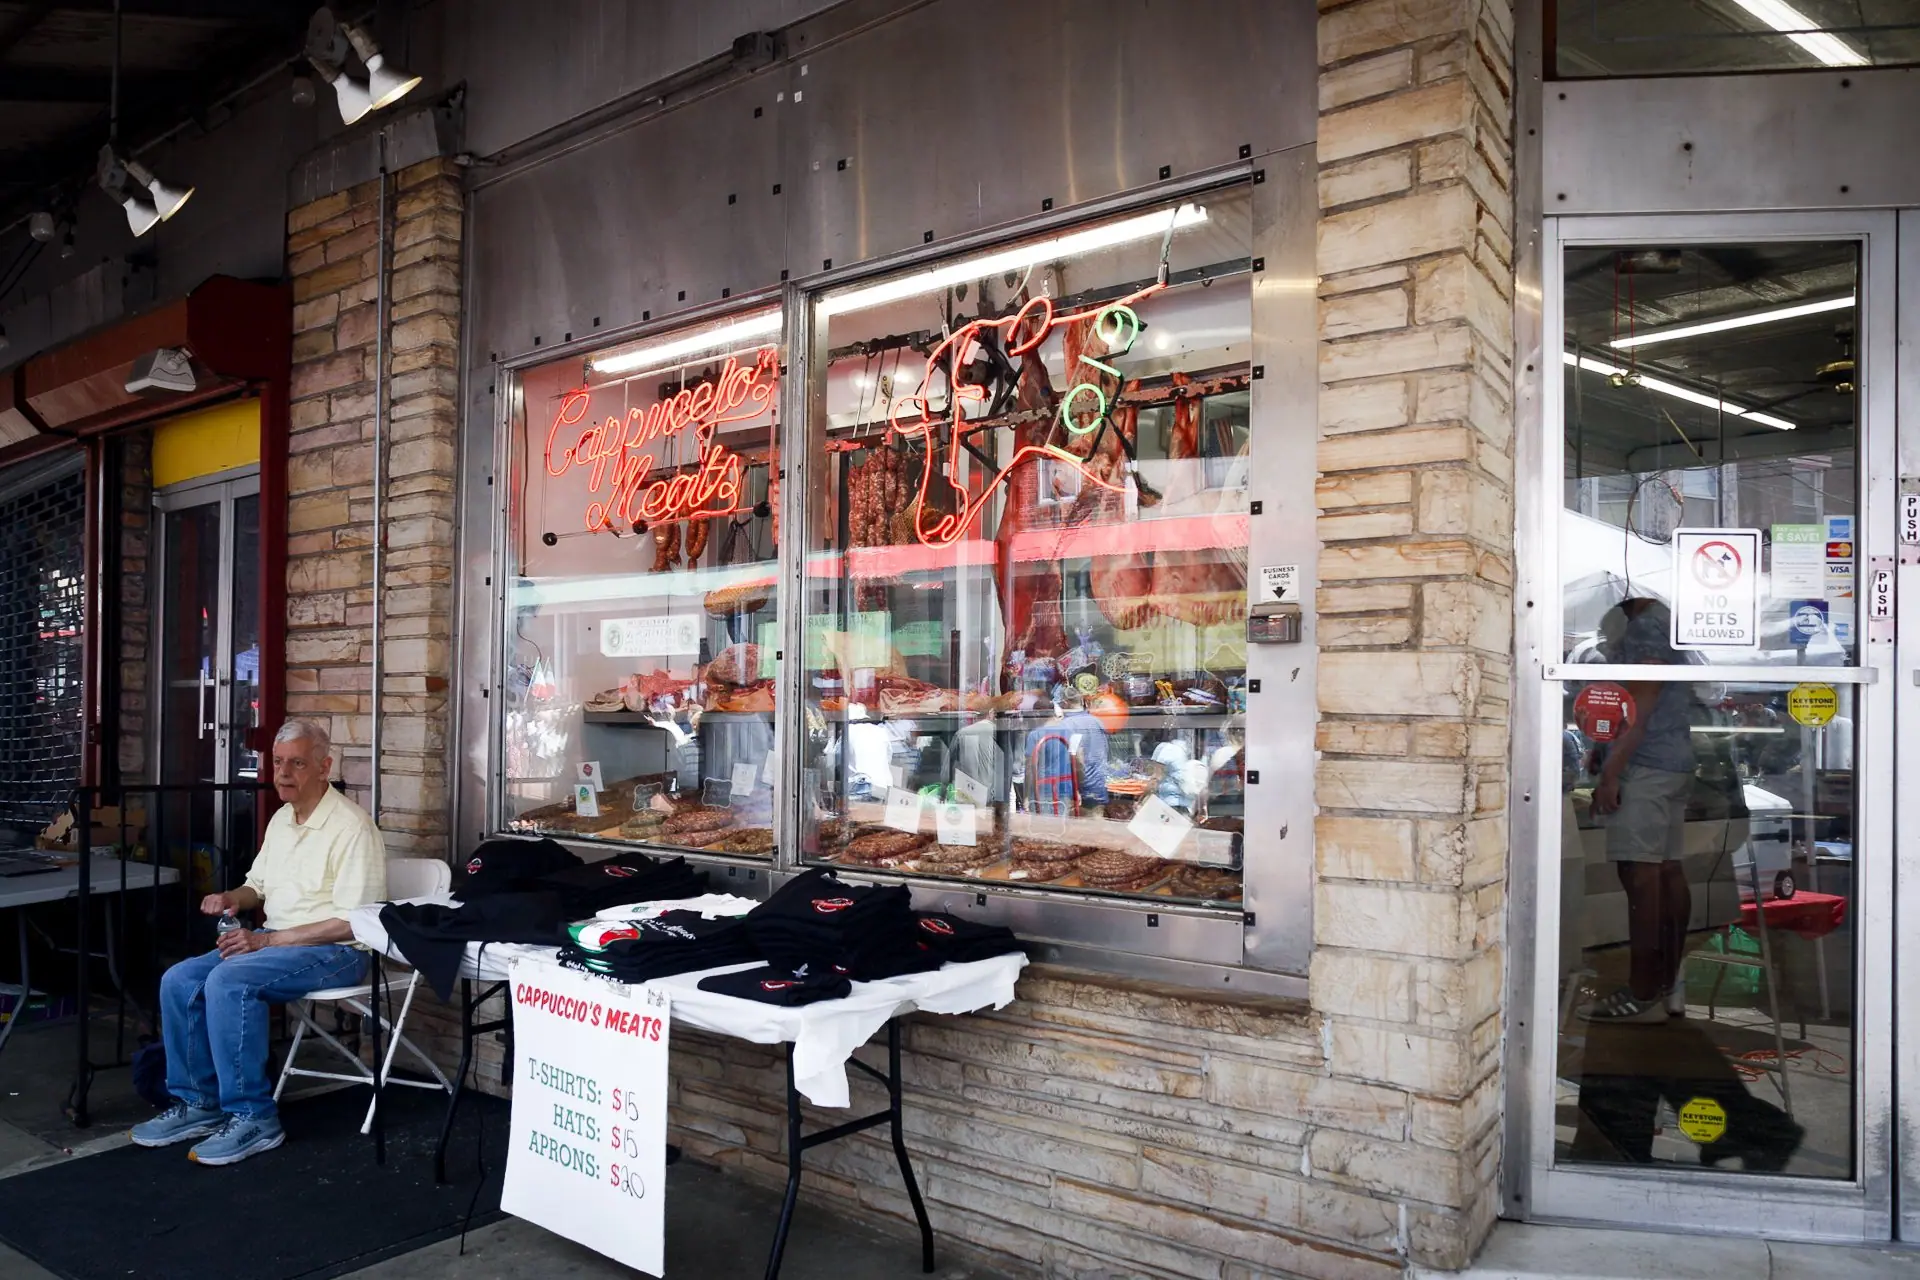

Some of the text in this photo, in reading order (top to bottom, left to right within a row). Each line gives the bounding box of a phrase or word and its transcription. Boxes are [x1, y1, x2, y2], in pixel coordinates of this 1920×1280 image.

[585, 444, 740, 531] Meats
[1786, 532, 1820, 541] SAVE!
[1907, 497, 1918, 541] PUSH
[1263, 566, 1295, 574] BUSINESS
[1703, 595, 1728, 608] NO
[1877, 572, 1888, 616] PUSH
[1686, 628, 1745, 639] ALLOWED
[1693, 612, 1738, 625] PETS
[516, 982, 662, 1042] CAPPUCCIO'S MEATS
[528, 1057, 639, 1122] T-SHIRTS: $15
[553, 1103, 639, 1159] HATS: $15
[1683, 1113, 1723, 1121] KEYSTONE
[528, 1129, 645, 1200] APRONS: $20
